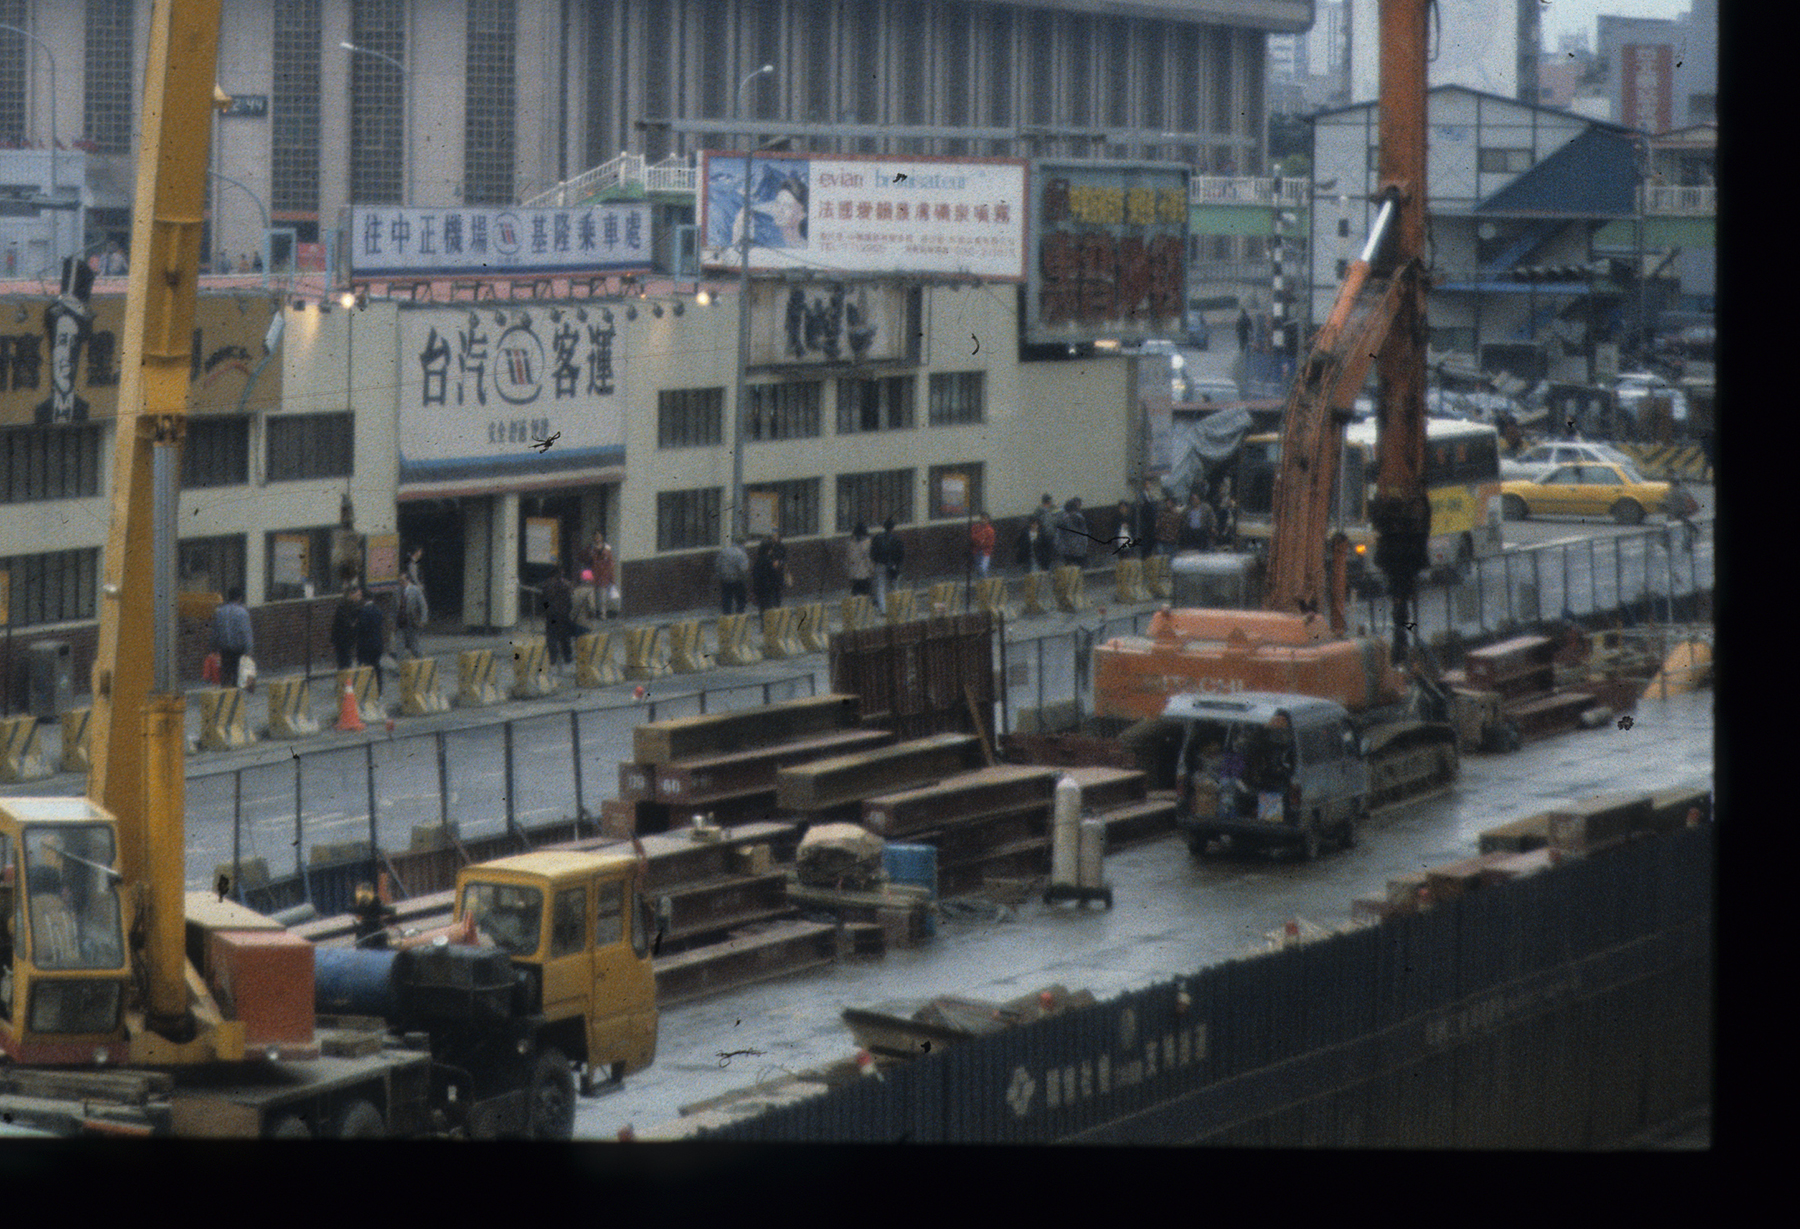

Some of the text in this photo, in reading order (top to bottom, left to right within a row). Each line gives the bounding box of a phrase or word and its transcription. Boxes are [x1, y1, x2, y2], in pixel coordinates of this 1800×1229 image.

[819, 168, 863, 188] evian
[364, 209, 641, 255] 往中正機場 基隆乘車處
[419, 321, 616, 407] 台汽 客運
